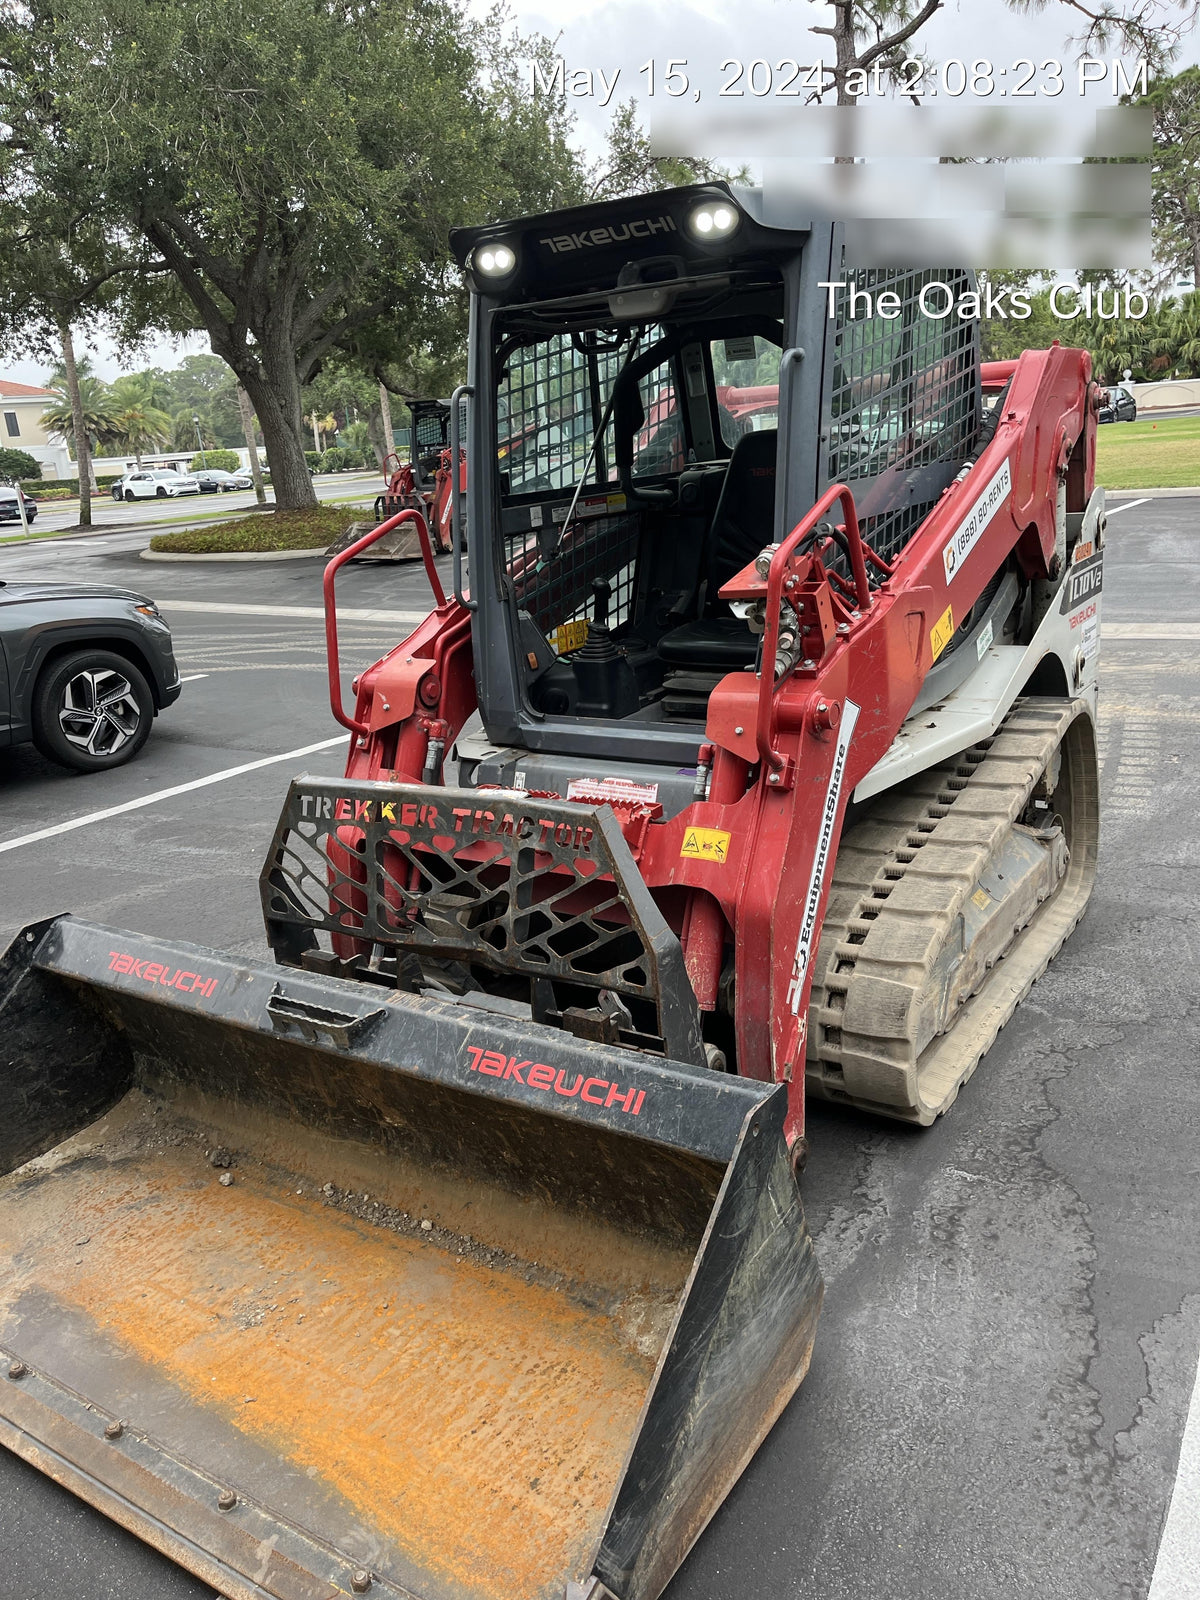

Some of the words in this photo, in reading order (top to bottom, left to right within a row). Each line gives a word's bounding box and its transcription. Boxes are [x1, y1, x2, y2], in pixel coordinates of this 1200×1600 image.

[957, 515, 978, 555] (888)
[300, 794, 439, 830] TREKKER
[452, 808, 595, 853] TRACTOR
[801, 744, 845, 944] EquipmentShare
